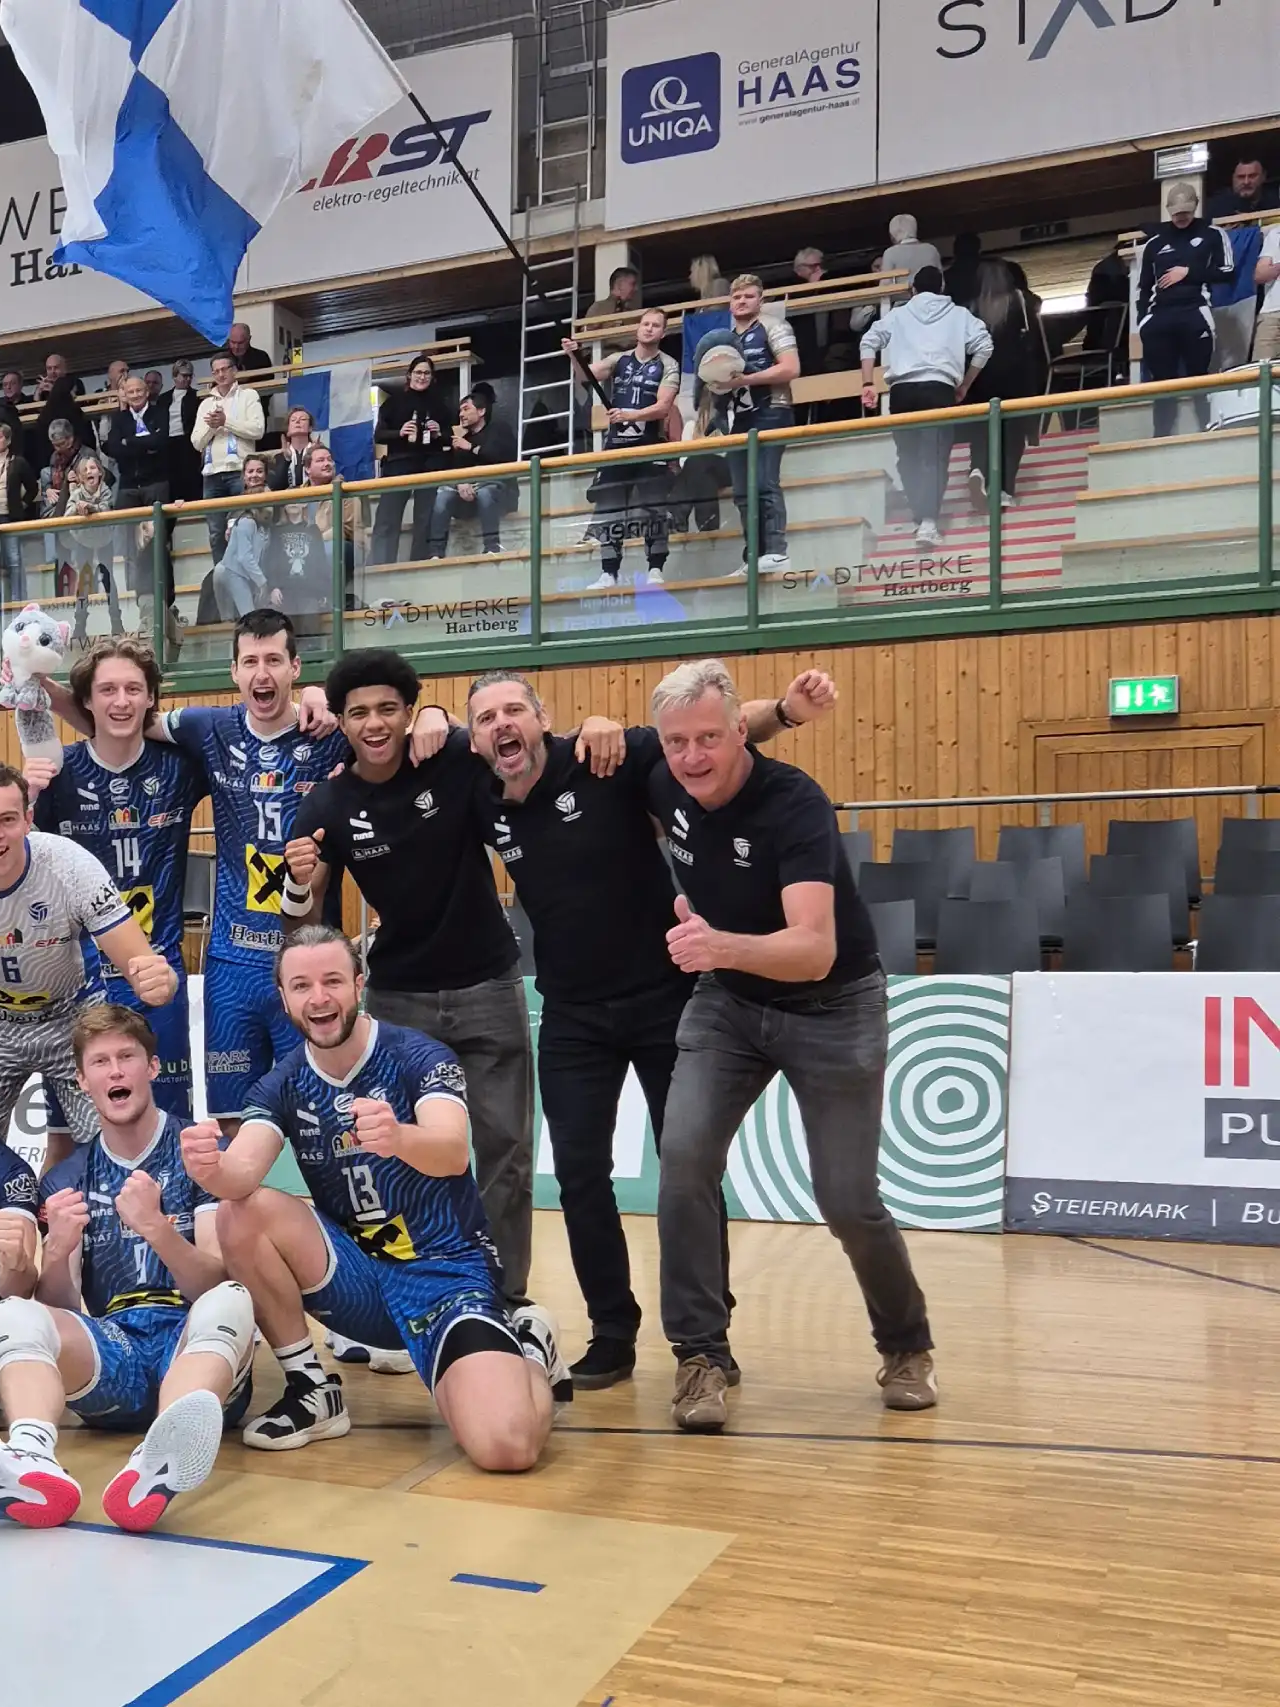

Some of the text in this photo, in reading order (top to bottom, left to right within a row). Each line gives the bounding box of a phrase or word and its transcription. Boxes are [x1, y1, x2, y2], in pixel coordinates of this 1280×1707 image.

[738, 40, 860, 75] GeneralAgentur
[738, 58, 861, 109] HAAS
[628, 113, 713, 147] UNIQA
[297, 109, 492, 193] RST
[782, 554, 973, 592] STADTWERKE
[882, 575, 973, 598] Hartberg
[363, 596, 519, 630] STADTWERKE
[445, 616, 519, 635] Hartberg
[80, 803, 100, 811] nine
[253, 799, 282, 842] 15
[111, 837, 142, 878] 14
[231, 922, 288, 946] Hartb
[1, 956, 22, 984] 6
[299, 1127, 321, 1137] nine
[342, 1164, 381, 1213] 13
[1030, 1191, 1189, 1220] STEIERMARK
